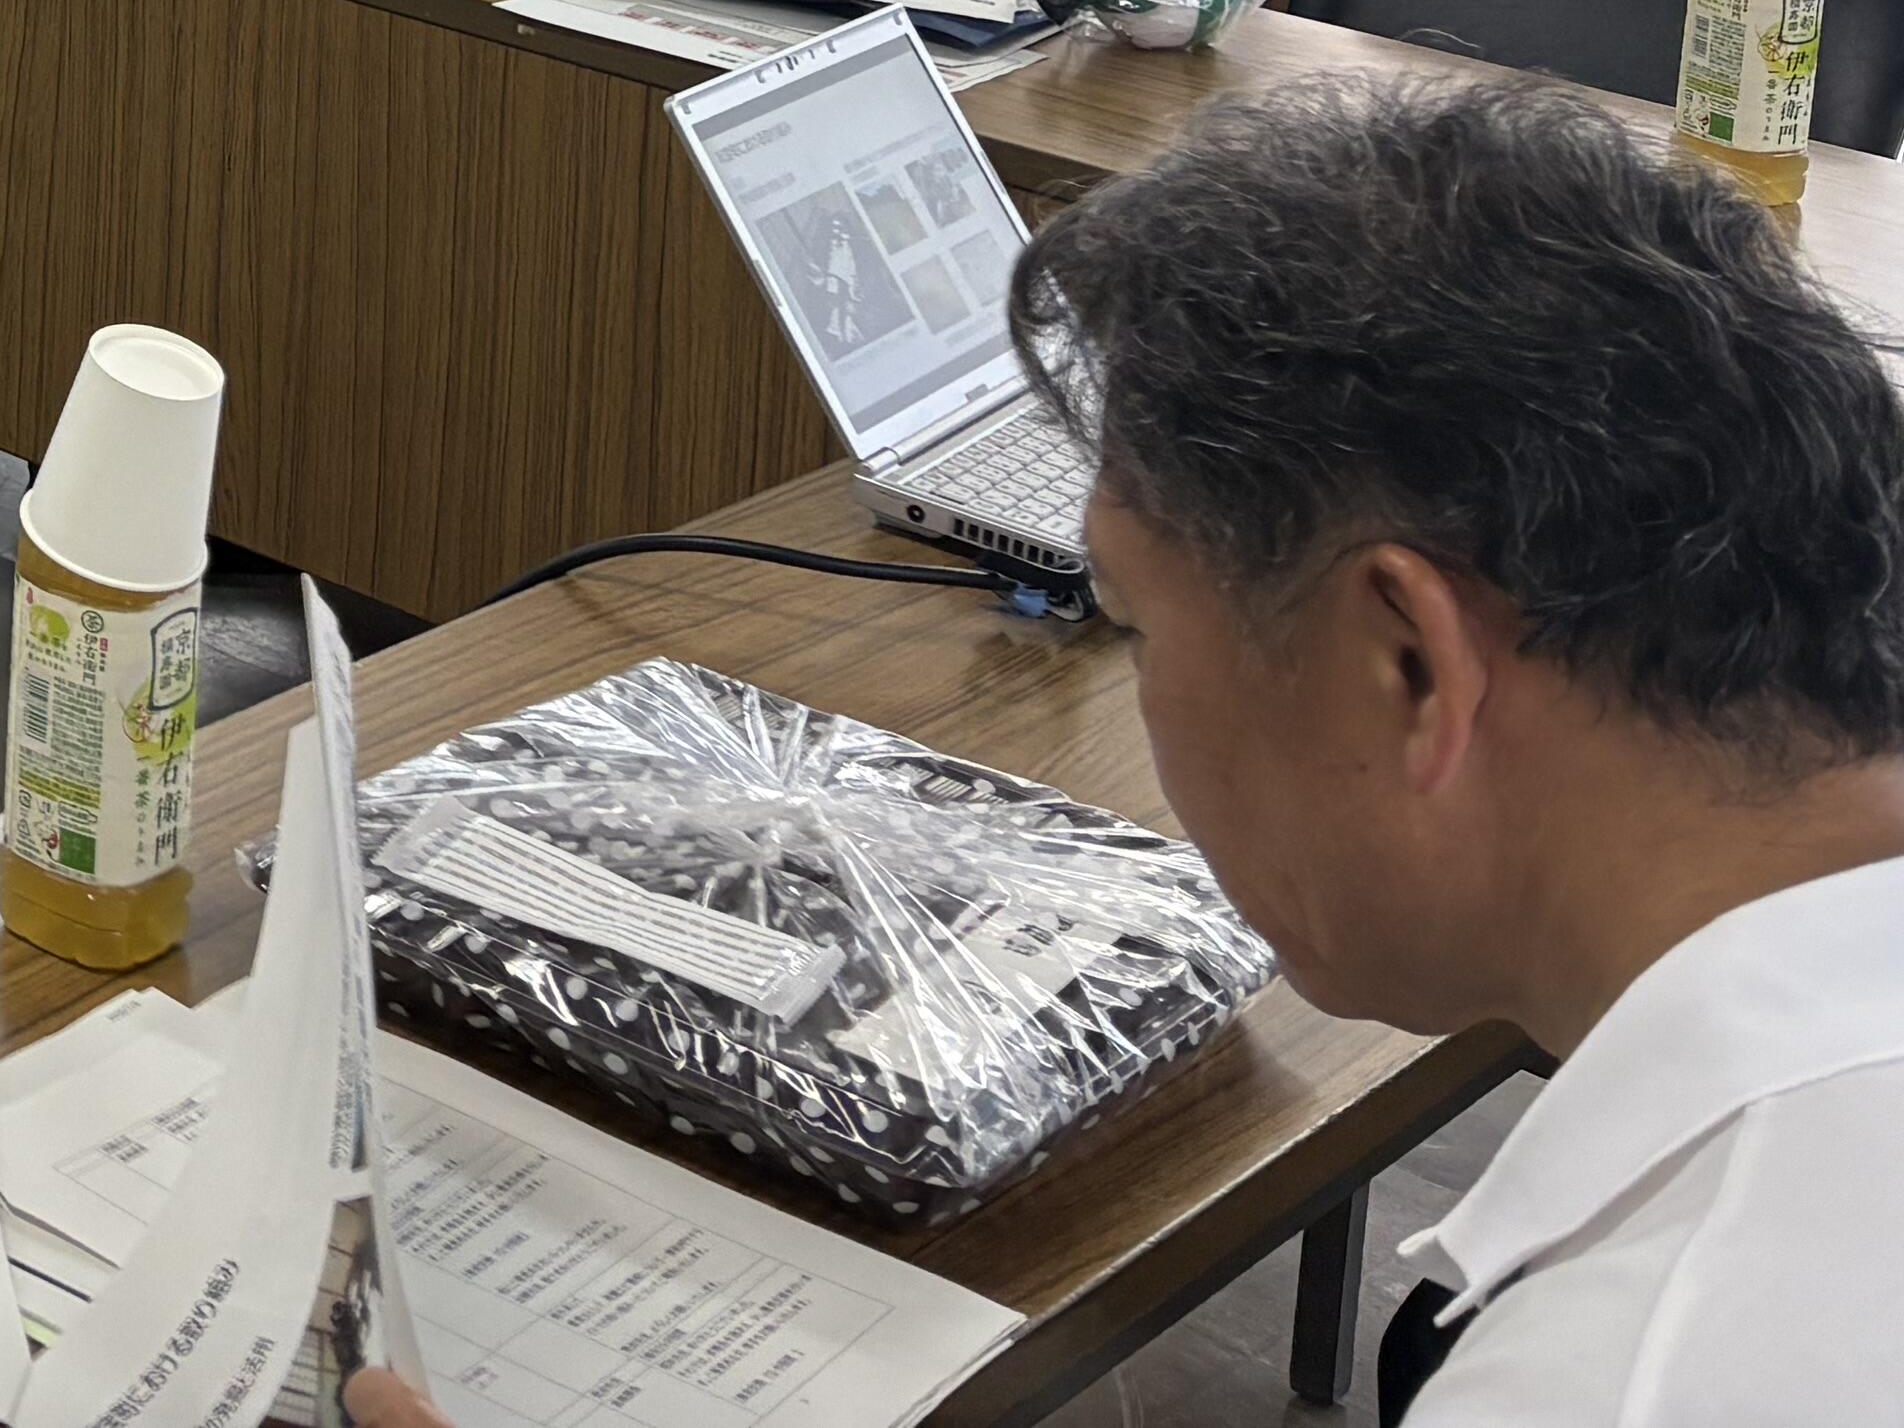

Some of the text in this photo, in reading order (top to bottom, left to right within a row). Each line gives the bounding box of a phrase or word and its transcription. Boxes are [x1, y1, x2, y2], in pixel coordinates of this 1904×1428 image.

[1777, 51, 1810, 146] 伊右衛門
[153, 716, 185, 867] 伊右衛門
